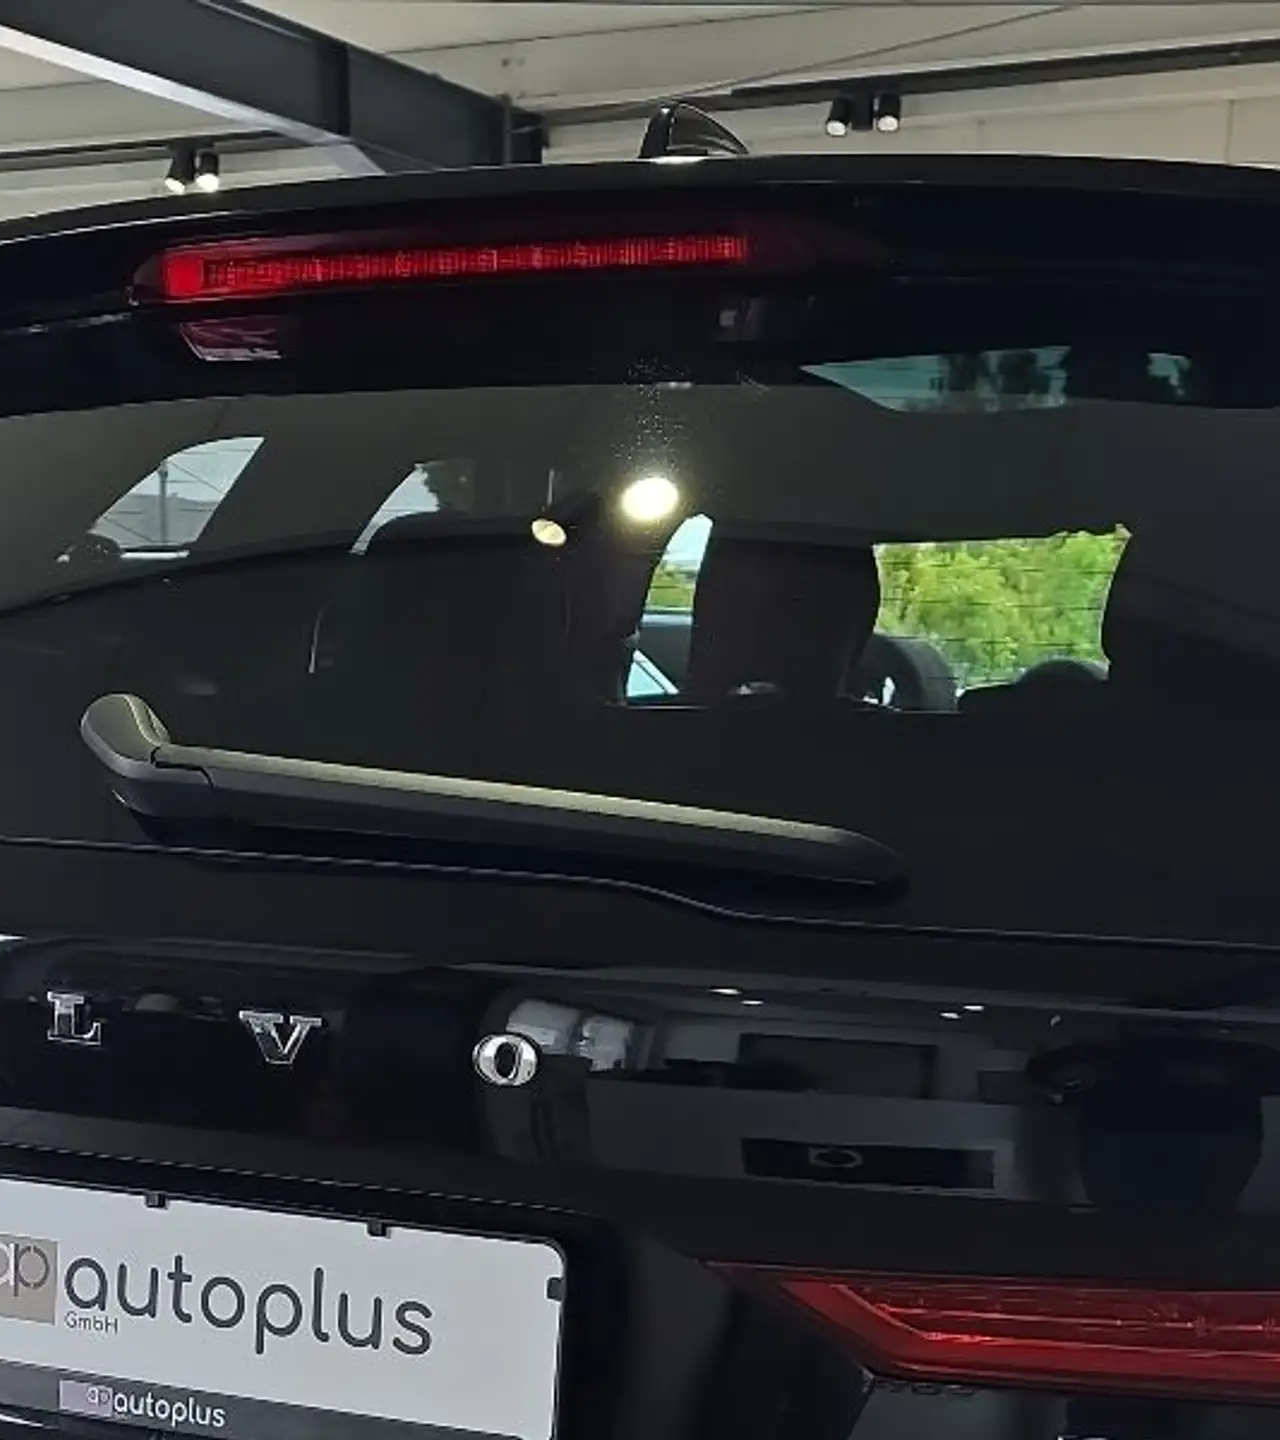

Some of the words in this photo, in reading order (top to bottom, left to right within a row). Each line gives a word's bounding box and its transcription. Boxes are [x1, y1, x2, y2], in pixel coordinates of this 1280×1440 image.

[64, 1254, 432, 1354] autoplus
[64, 1310, 118, 1334] GmbH
[114, 1392, 226, 1427] autoplus
